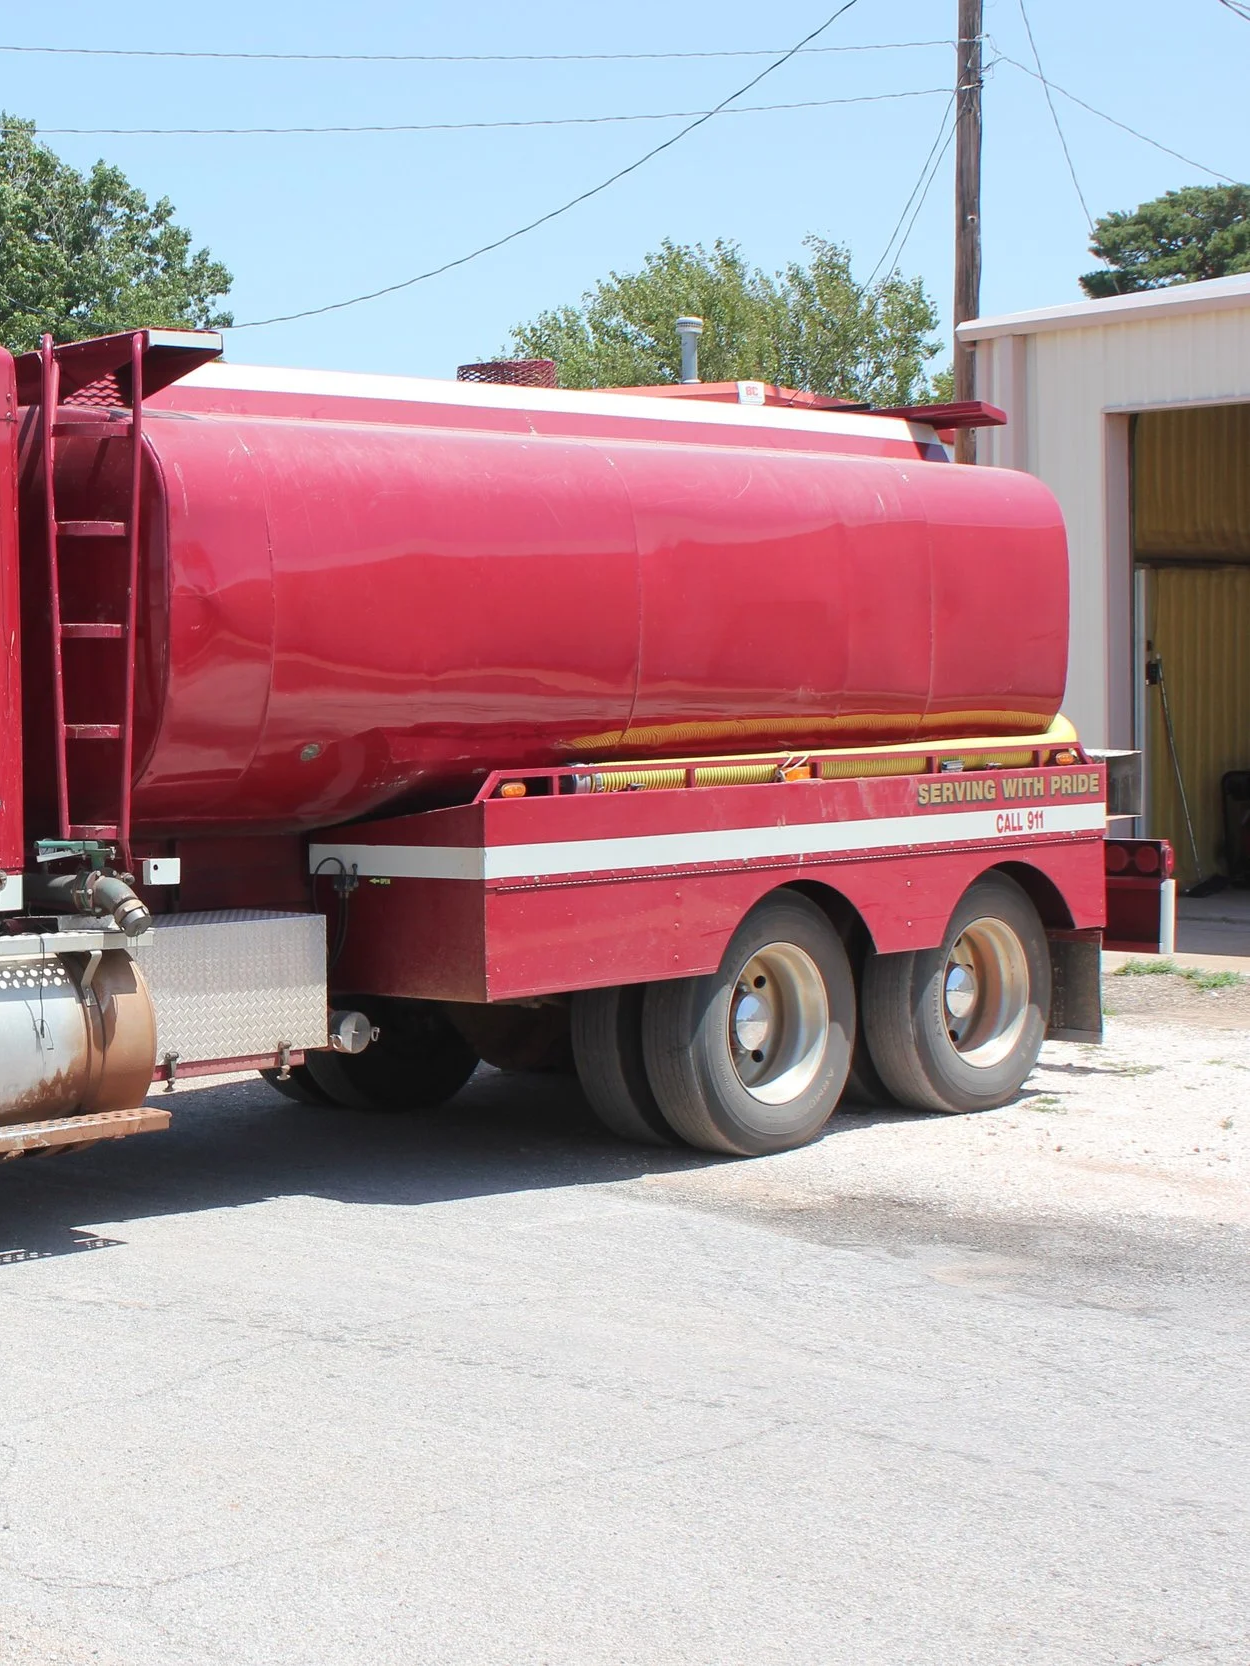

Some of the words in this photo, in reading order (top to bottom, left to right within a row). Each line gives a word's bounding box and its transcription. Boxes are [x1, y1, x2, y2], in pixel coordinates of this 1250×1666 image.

[917, 779, 996, 805] SERVING
[1002, 776, 1045, 799] WITH
[1051, 773, 1100, 796] PRIDE
[996, 811, 1023, 833] CALL
[1027, 810, 1044, 830] 911
